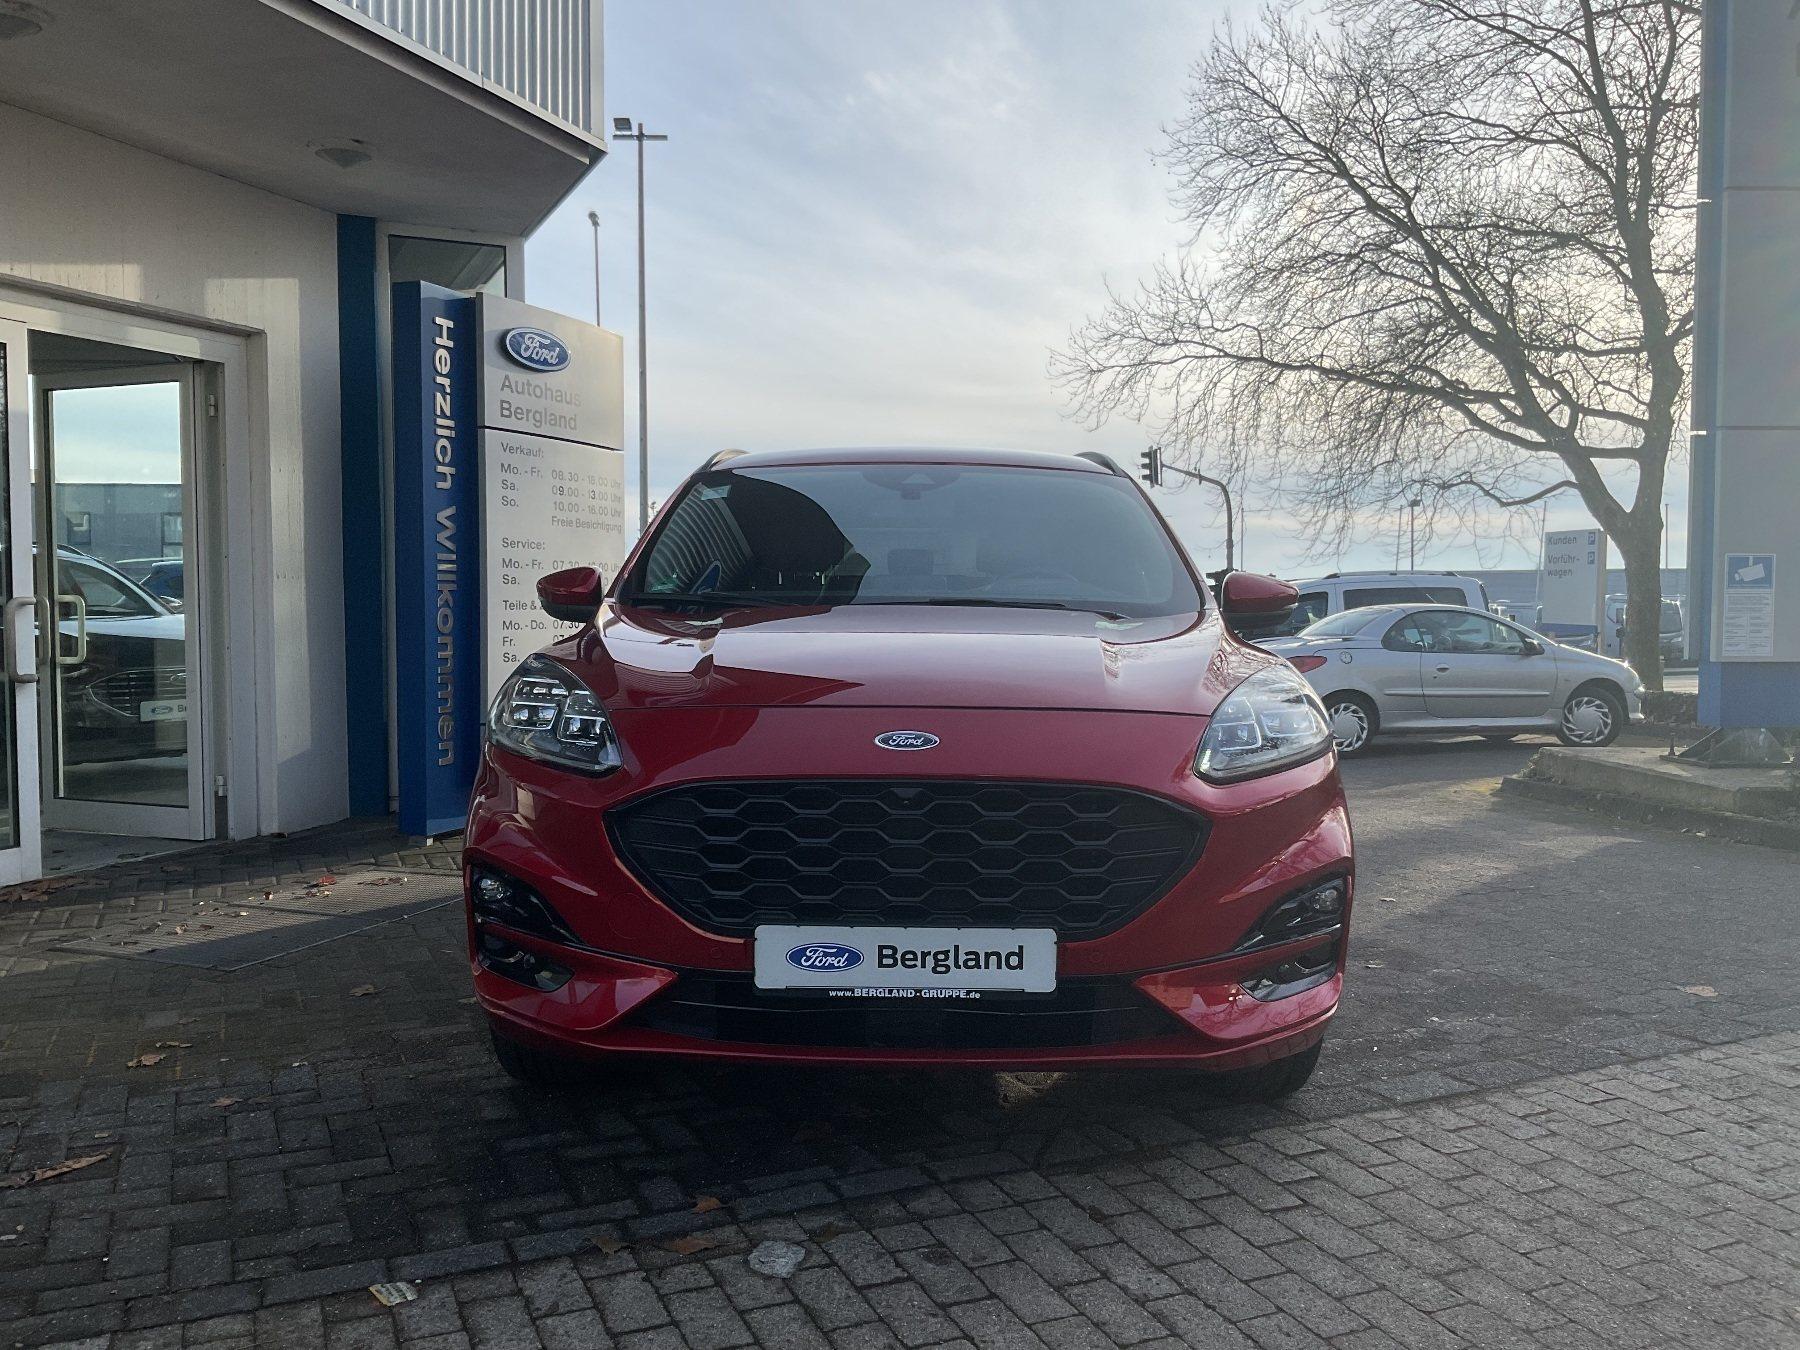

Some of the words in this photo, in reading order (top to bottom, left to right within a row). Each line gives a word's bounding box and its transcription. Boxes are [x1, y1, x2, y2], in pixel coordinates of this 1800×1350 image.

[520, 333, 560, 365] Ford
[500, 374, 582, 408] Autohaus
[433, 316, 457, 490] Herzlich
[500, 400, 578, 432] Bergland
[501, 441, 544, 459] Verkauf:
[500, 462, 522, 476] Mo.
[530, 466, 543, 479] Fr.
[551, 469, 579, 483] 08.30
[501, 479, 519, 492] Sa.
[551, 484, 579, 498] 09.00
[501, 495, 519, 508] So.
[553, 501, 579, 514] 10.00
[551, 515, 574, 528] Freie
[502, 537, 546, 551] Service:
[1547, 536, 1577, 545] Kunden
[502, 558, 523, 570] Mo.
[531, 559, 544, 570] Fr.
[502, 574, 520, 585] Sa.
[1547, 569, 1573, 579] wagen
[502, 600, 528, 611] Teile
[530, 600, 537, 611] &
[502, 620, 523, 631] Mo.
[530, 620, 547, 630] Do.
[435, 505, 458, 767] Willkommen
[502, 636, 516, 647] Fr.
[502, 652, 520, 663] Sa.
[888, 734, 925, 746] Ford
[801, 946, 848, 968] Ford
[876, 944, 1025, 975] Bergland
